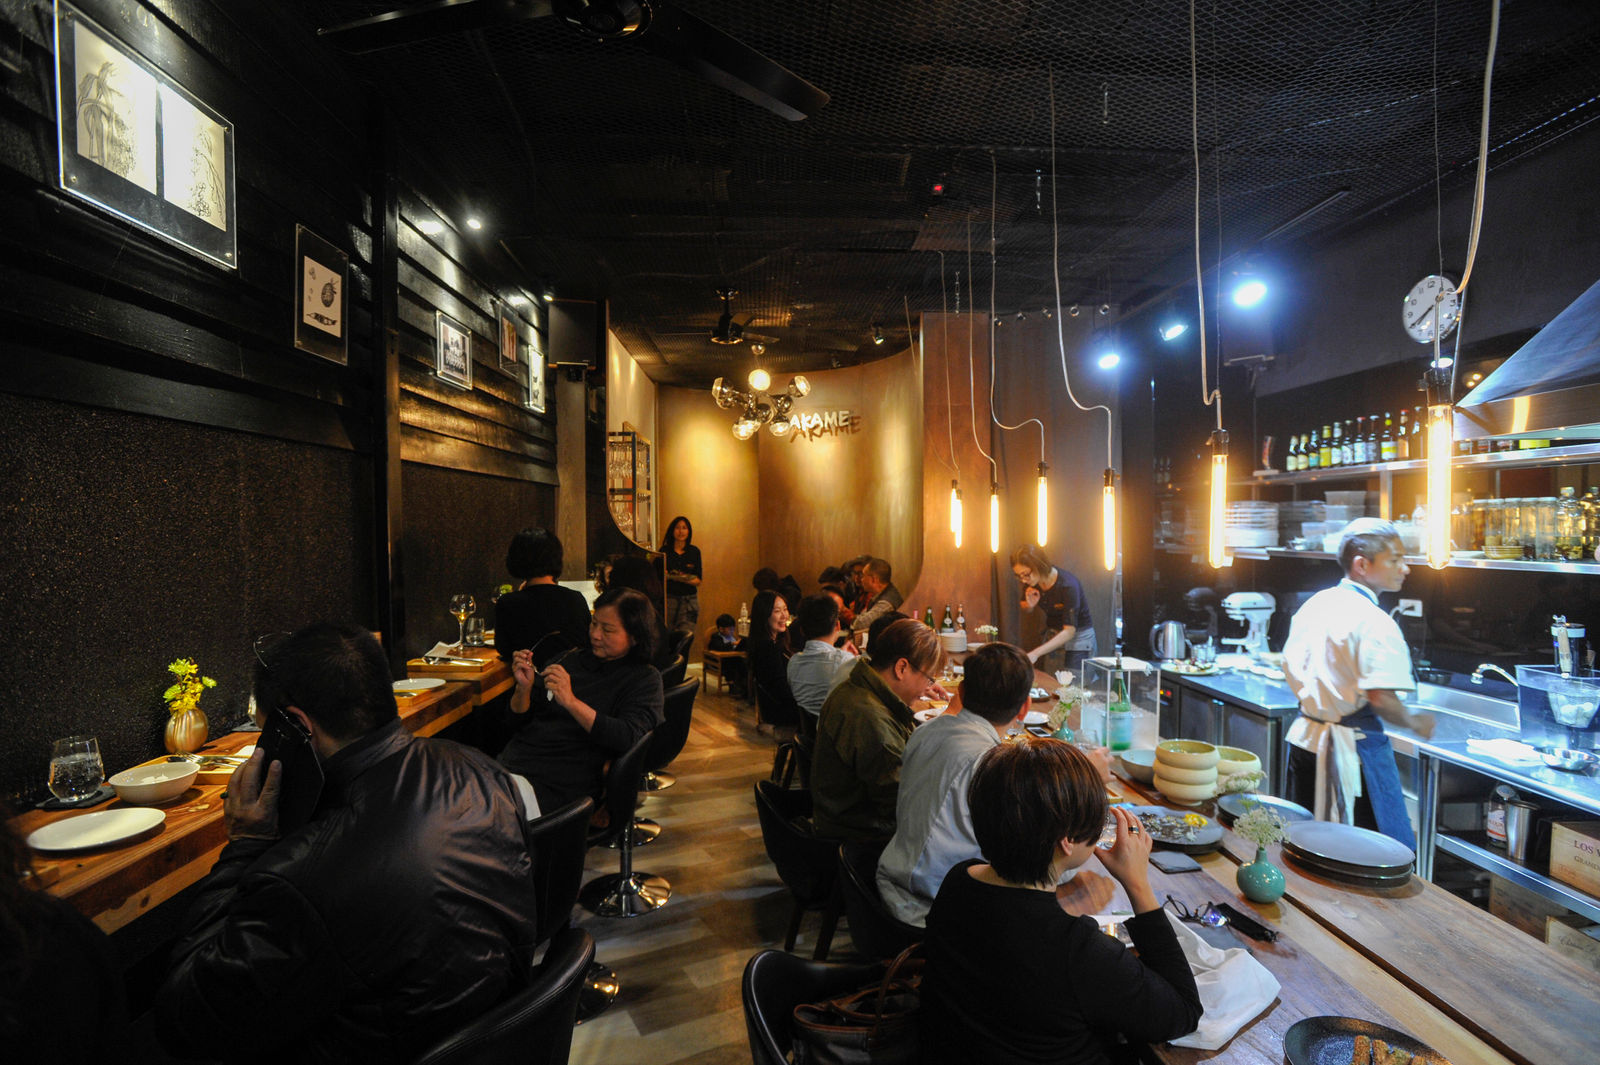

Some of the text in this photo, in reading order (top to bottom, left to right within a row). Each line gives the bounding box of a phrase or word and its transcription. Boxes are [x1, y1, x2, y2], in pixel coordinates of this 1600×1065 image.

[1427, 281, 1436, 289] 12
[1407, 311, 1413, 319] 9
[790, 411, 849, 431] AKAME
[1574, 839, 1593, 855] LOS
